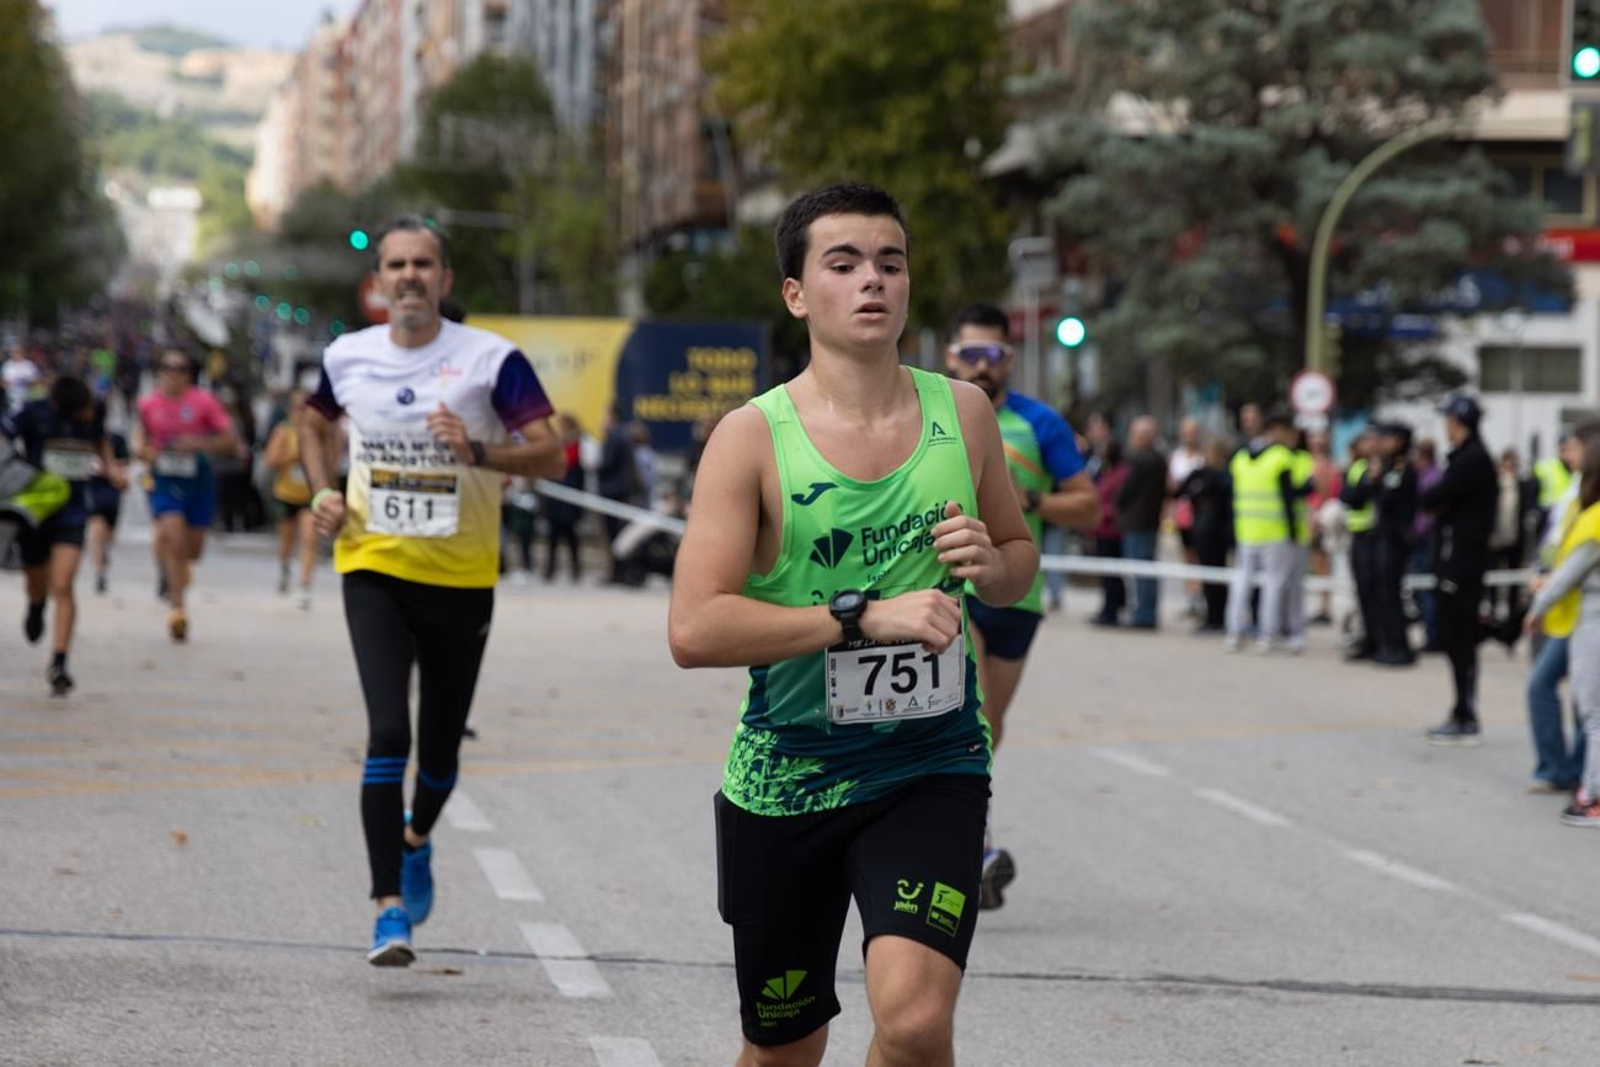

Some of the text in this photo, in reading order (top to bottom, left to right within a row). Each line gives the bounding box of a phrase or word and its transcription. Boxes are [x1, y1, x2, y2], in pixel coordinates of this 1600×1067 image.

[384, 495, 433, 521] 611
[858, 651, 940, 696] 751
[756, 996, 815, 1012] Fundación
[758, 1009, 800, 1019] Unicaja
